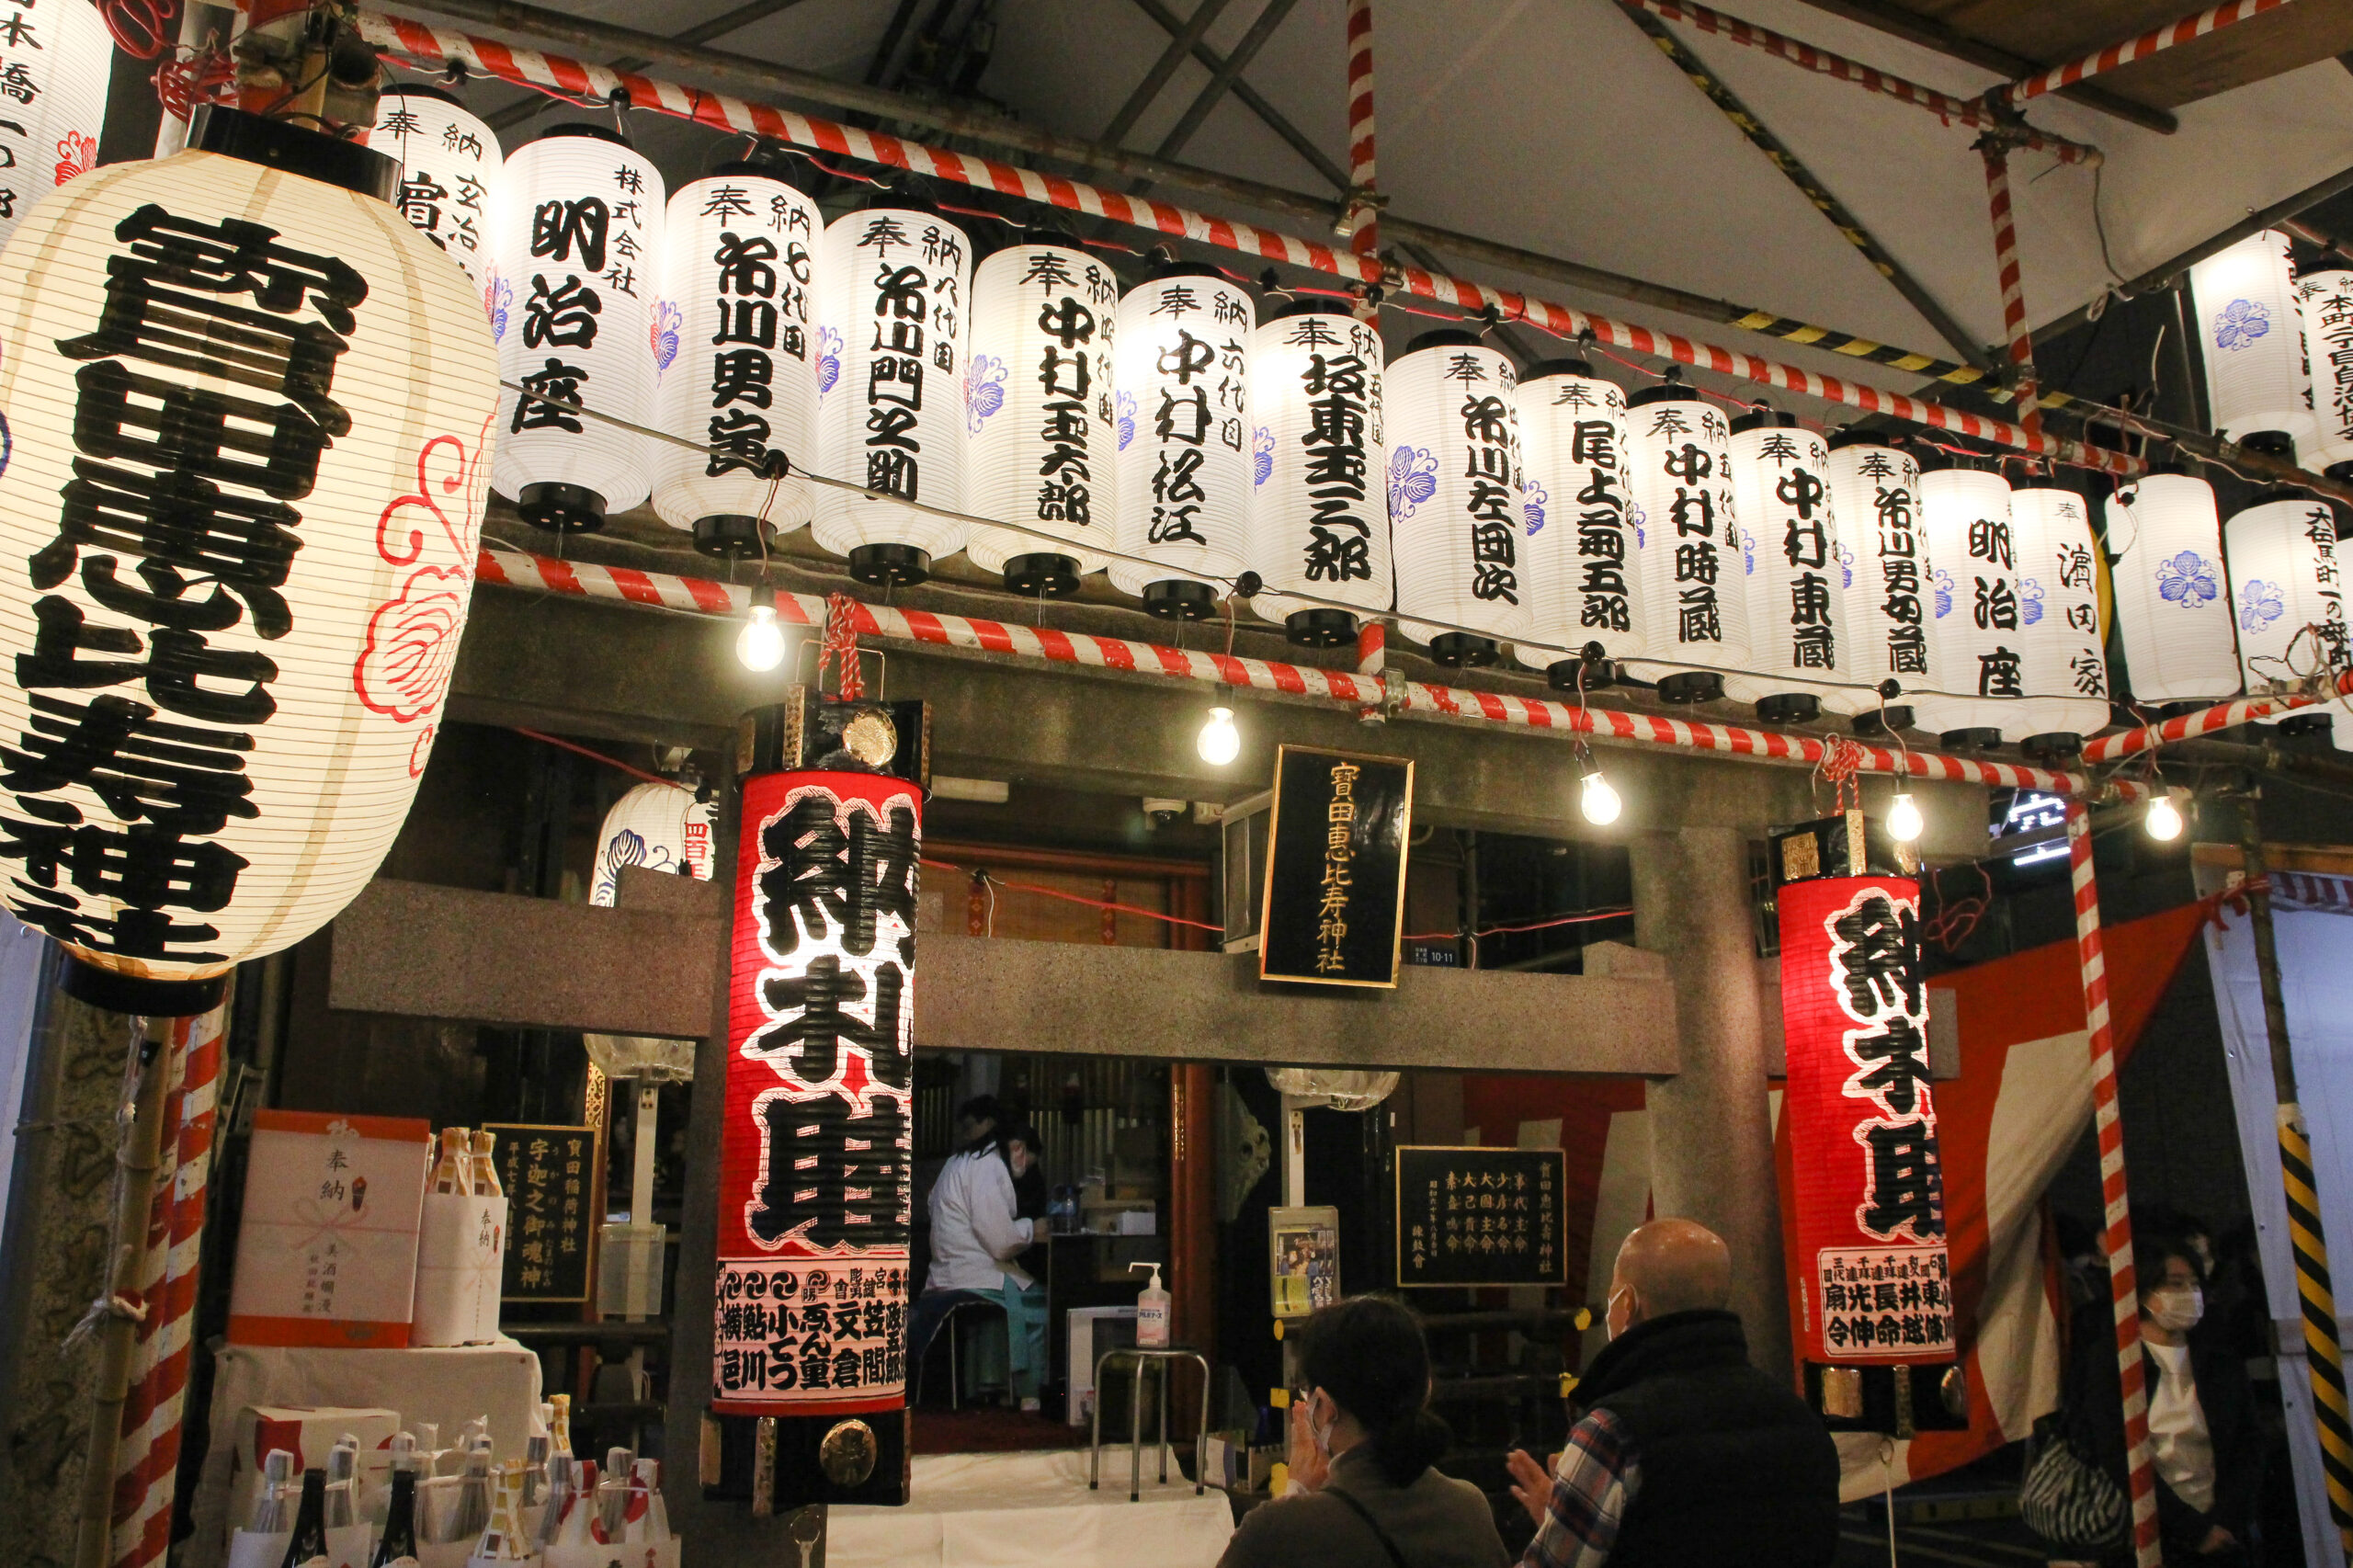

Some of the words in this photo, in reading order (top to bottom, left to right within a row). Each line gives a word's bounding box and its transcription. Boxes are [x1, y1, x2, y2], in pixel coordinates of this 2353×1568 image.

[510, 197, 609, 434] 明治座
[601, 164, 645, 300] 株式会社
[1037, 297, 1095, 526] 中村玉太郎
[1148, 328, 1215, 546] 中村松江
[1301, 354, 1372, 583] 坂東玉三郎
[1664, 443, 1722, 643] 中村時蔵
[1776, 467, 1836, 670] 中村東蔵
[1968, 518, 2024, 698] 明治座
[320, 1150, 348, 1201] 奉納
[479, 1208, 492, 1247] 奉納
